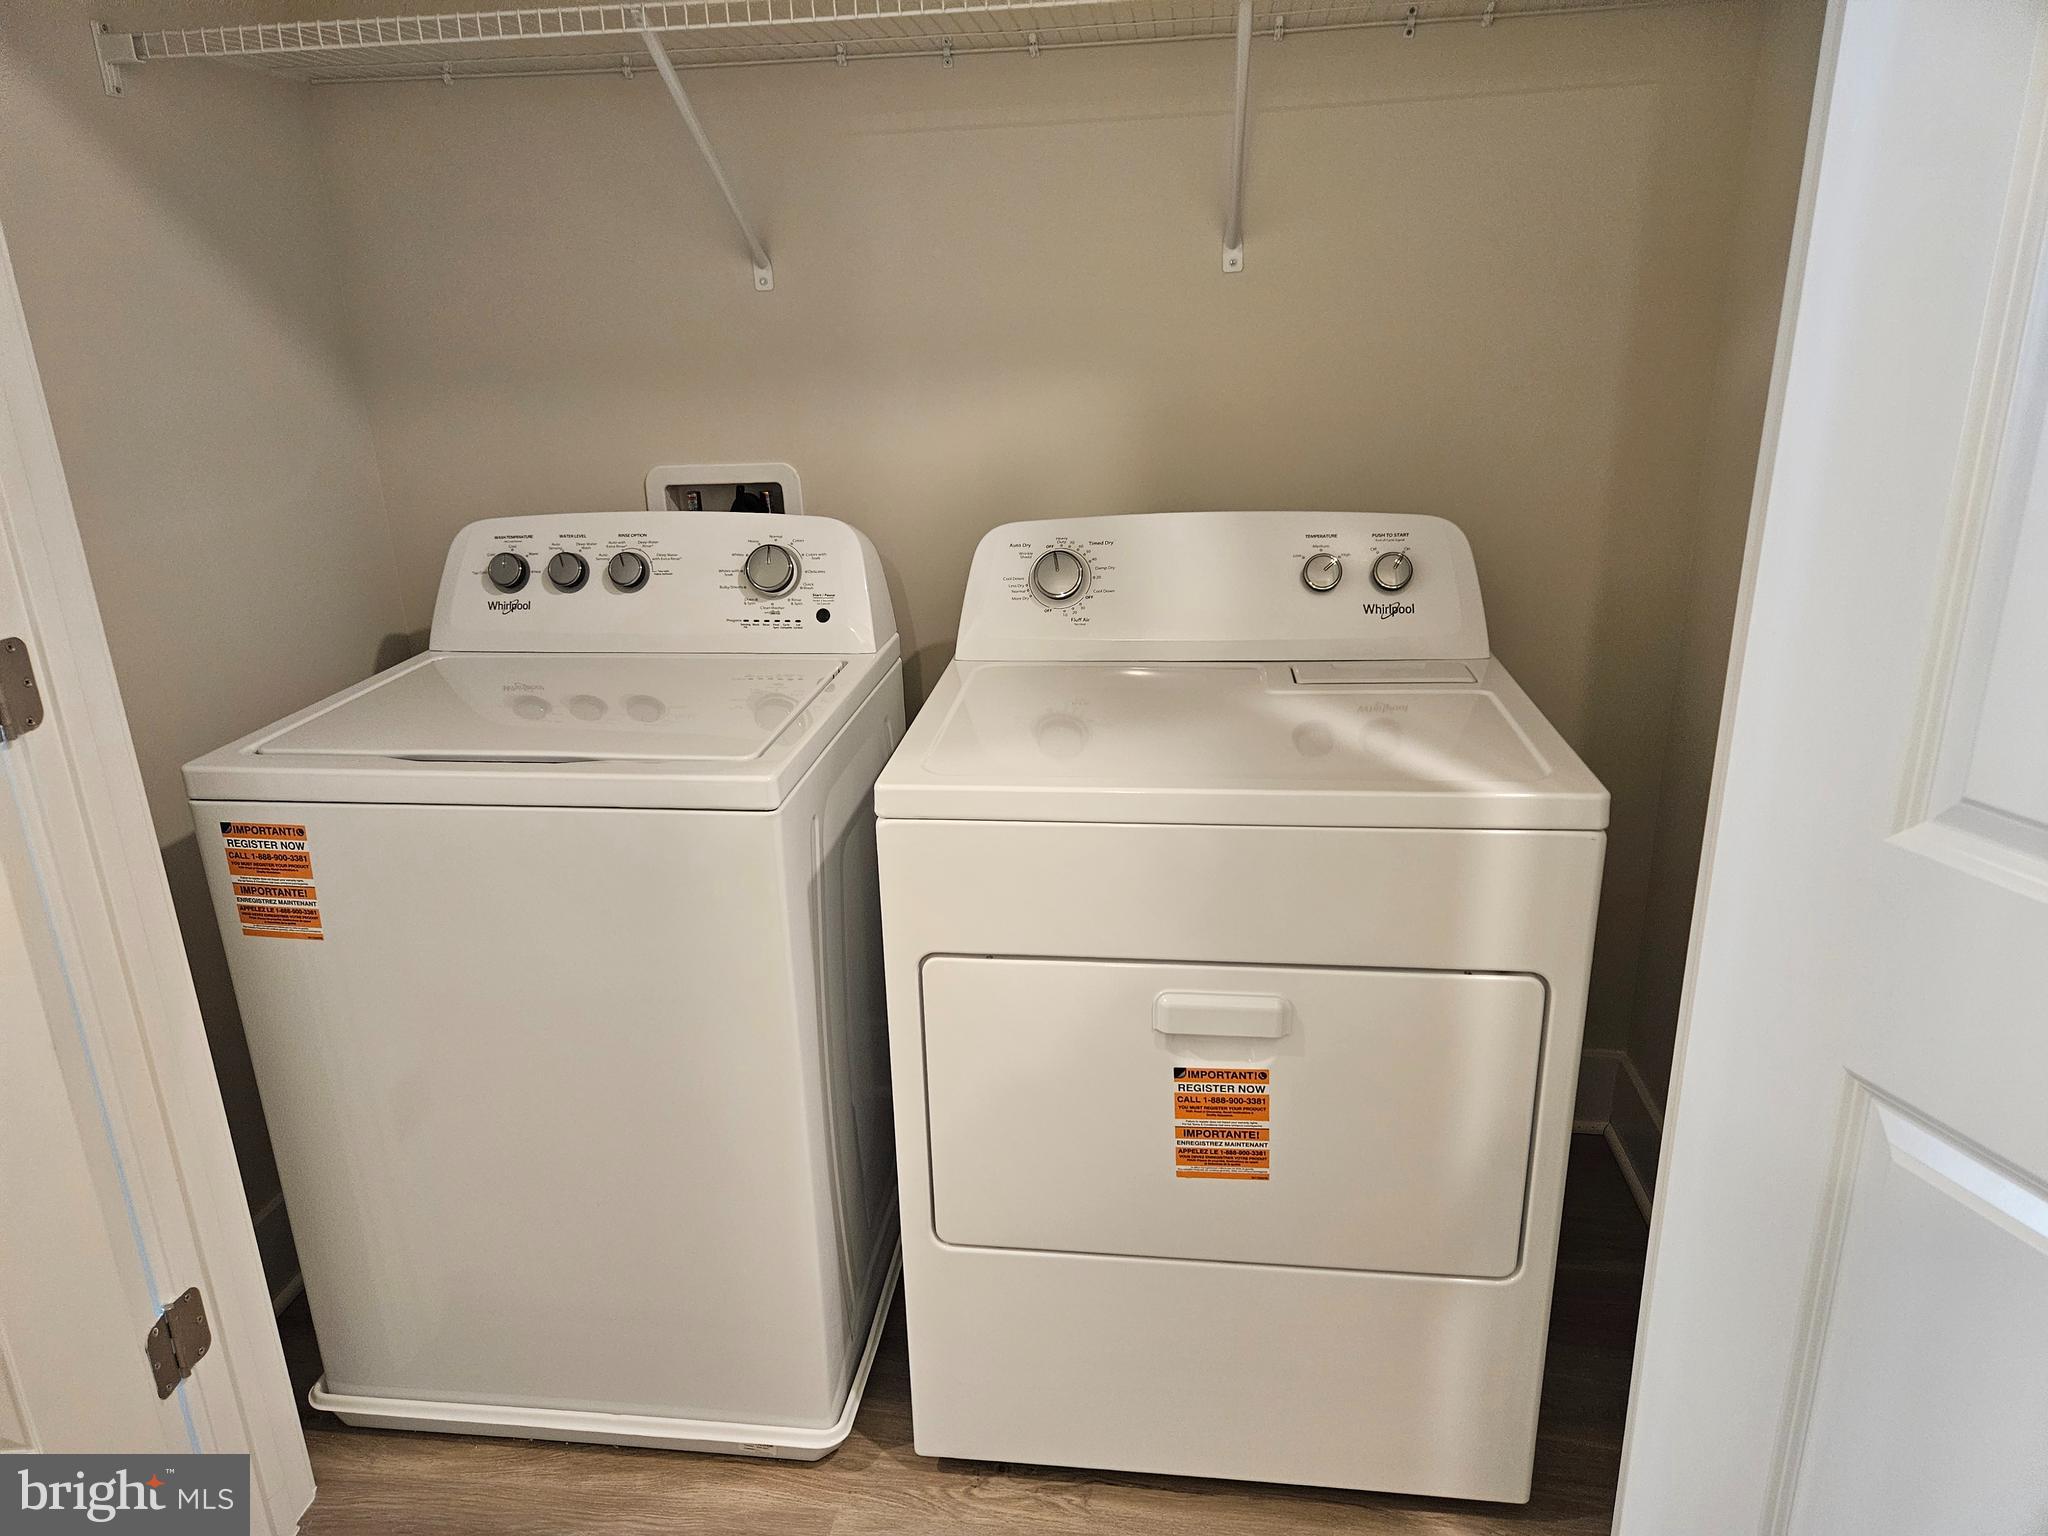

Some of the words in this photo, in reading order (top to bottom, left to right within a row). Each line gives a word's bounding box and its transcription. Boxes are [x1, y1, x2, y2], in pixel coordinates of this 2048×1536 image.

[487, 600, 531, 614] Whirlpool
[1362, 602, 1415, 619] Whirlpool
[232, 825, 296, 837] IMPORTANT!
[226, 838, 278, 850] REGISTER
[280, 841, 306, 851] NOW
[228, 851, 251, 860] CALL
[251, 853, 307, 862] 1-888-900-3381
[240, 886, 308, 898] IMPORTANTE!
[236, 897, 278, 905] ENREGISTREZ
[278, 899, 317, 907] MAINTENANT
[239, 905, 266, 913] APPELEZ
[1187, 1070, 1258, 1080] IMPORTANT!
[1178, 1083, 1235, 1093] REGISTER
[1238, 1085, 1266, 1094] NOW
[1203, 1096, 1266, 1105] 1-888-900-3381
[1183, 1129, 1260, 1140] IMPORTANTE!
